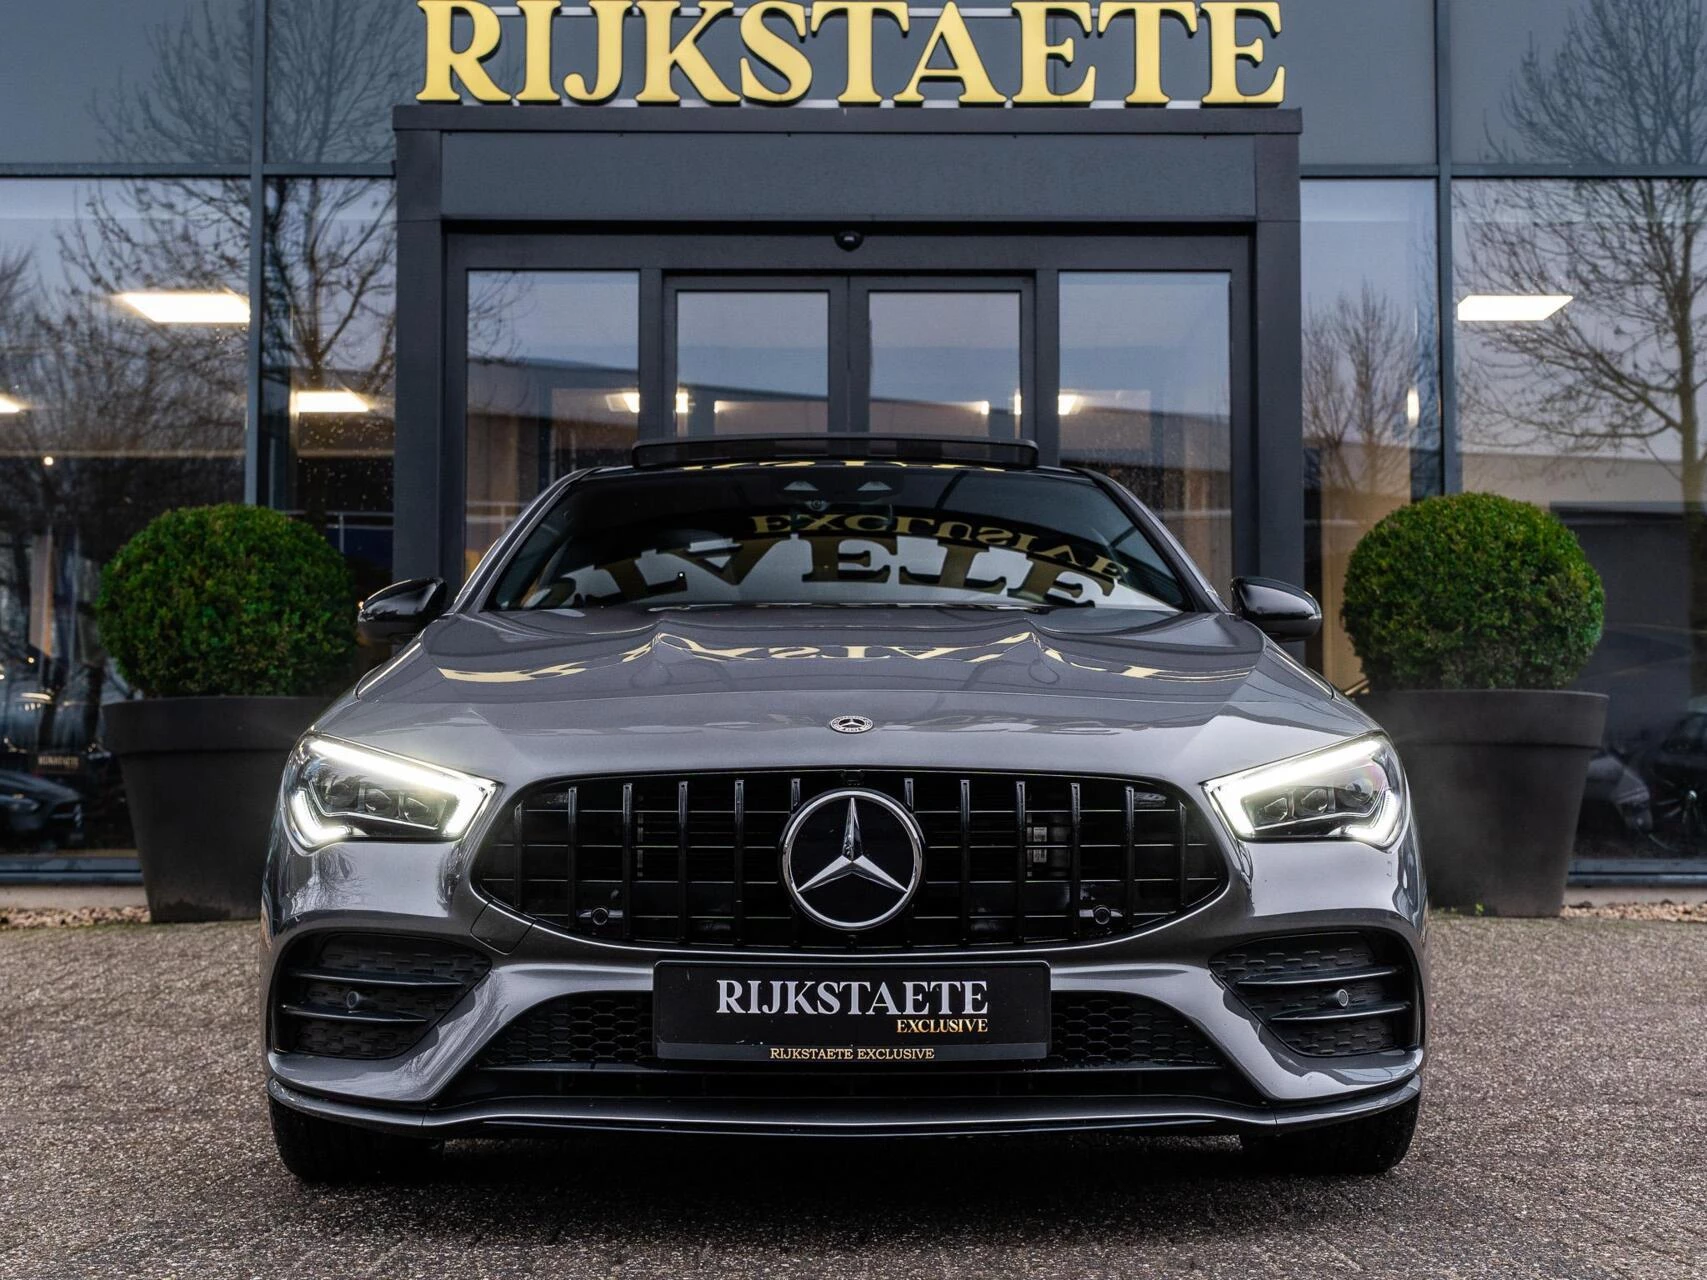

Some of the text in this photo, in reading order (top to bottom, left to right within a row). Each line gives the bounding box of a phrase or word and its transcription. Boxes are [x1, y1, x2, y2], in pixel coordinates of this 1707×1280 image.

[416, 0, 1286, 104] RIJKSTAETE
[716, 979, 988, 1015] RIJKSTAETE
[896, 1018, 988, 1033] EXCLUSIVE
[770, 1048, 935, 1060] RIJKSTAETE EXCLUSIVE
